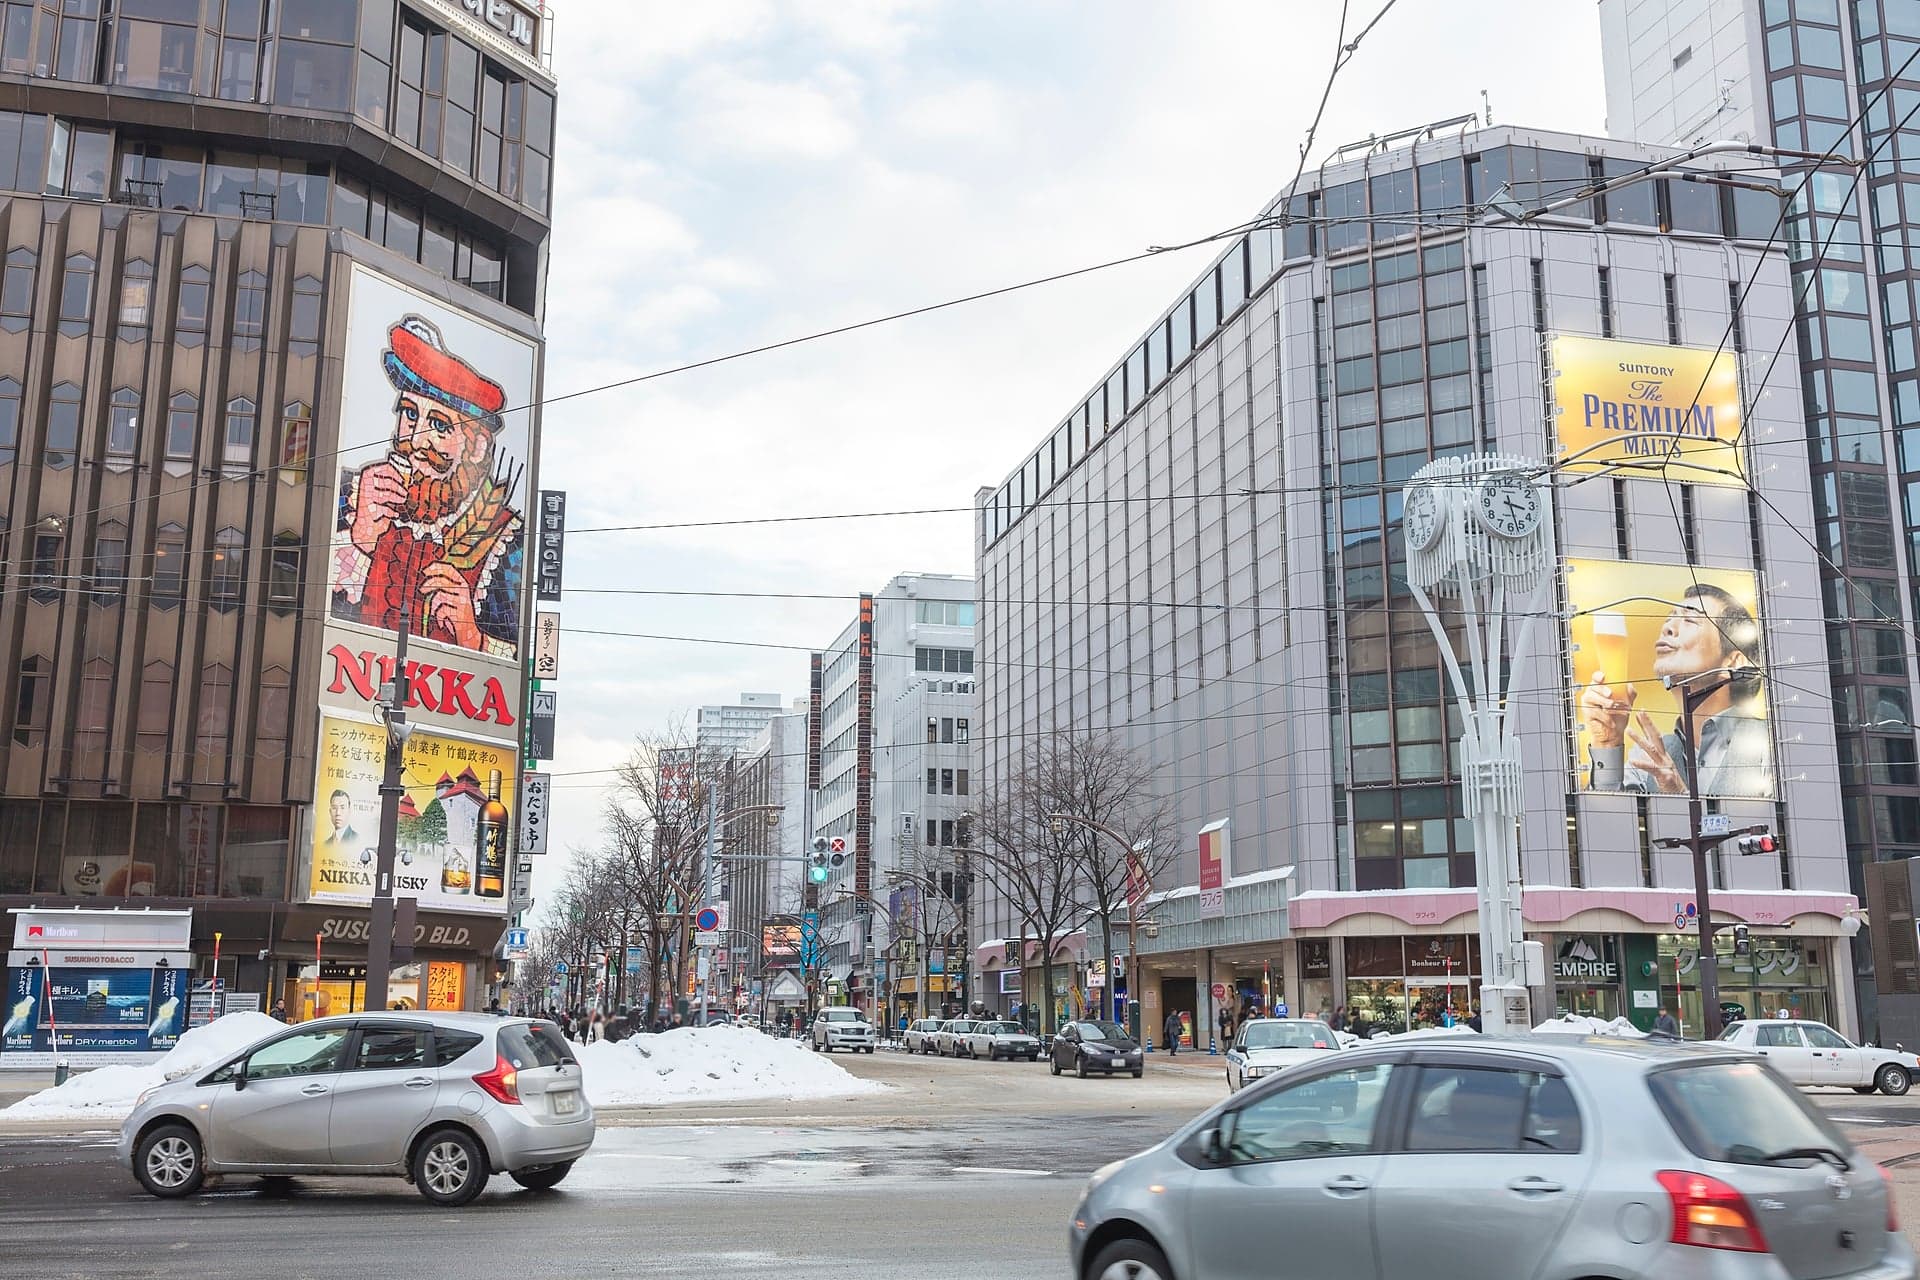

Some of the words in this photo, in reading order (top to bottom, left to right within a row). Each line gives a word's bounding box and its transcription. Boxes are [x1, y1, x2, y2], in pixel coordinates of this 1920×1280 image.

[1627, 380, 1664, 402] The
[1583, 393, 1717, 439] PREMIUM
[1623, 436, 1682, 458] MALT'S
[1485, 487, 1496, 497] 10
[1524, 489, 1531, 499] 2
[1484, 498, 1491, 508] 9
[1528, 501, 1535, 511] 3
[1488, 510, 1495, 520] 8
[1525, 513, 1532, 522] 4
[1497, 518, 1505, 528] 7
[1507, 522, 1515, 532] 6
[1518, 520, 1525, 530] 5
[327, 643, 516, 726] NIKKA
[526, 782, 542, 850] おたる亭
[1703, 816, 1728, 827] すすきの
[320, 869, 371, 886] NIKKA
[321, 919, 425, 943] SUSUO
[430, 926, 471, 946] BLD.
[101, 956, 135, 964] TOBACCO
[1411, 959, 1440, 967] Bonheur
[1678, 948, 1800, 976] クーニング
[1553, 962, 1617, 976] EMPIRE
[120, 1008, 144, 1017] Marlboro
[7, 1035, 32, 1045] Marlboro
